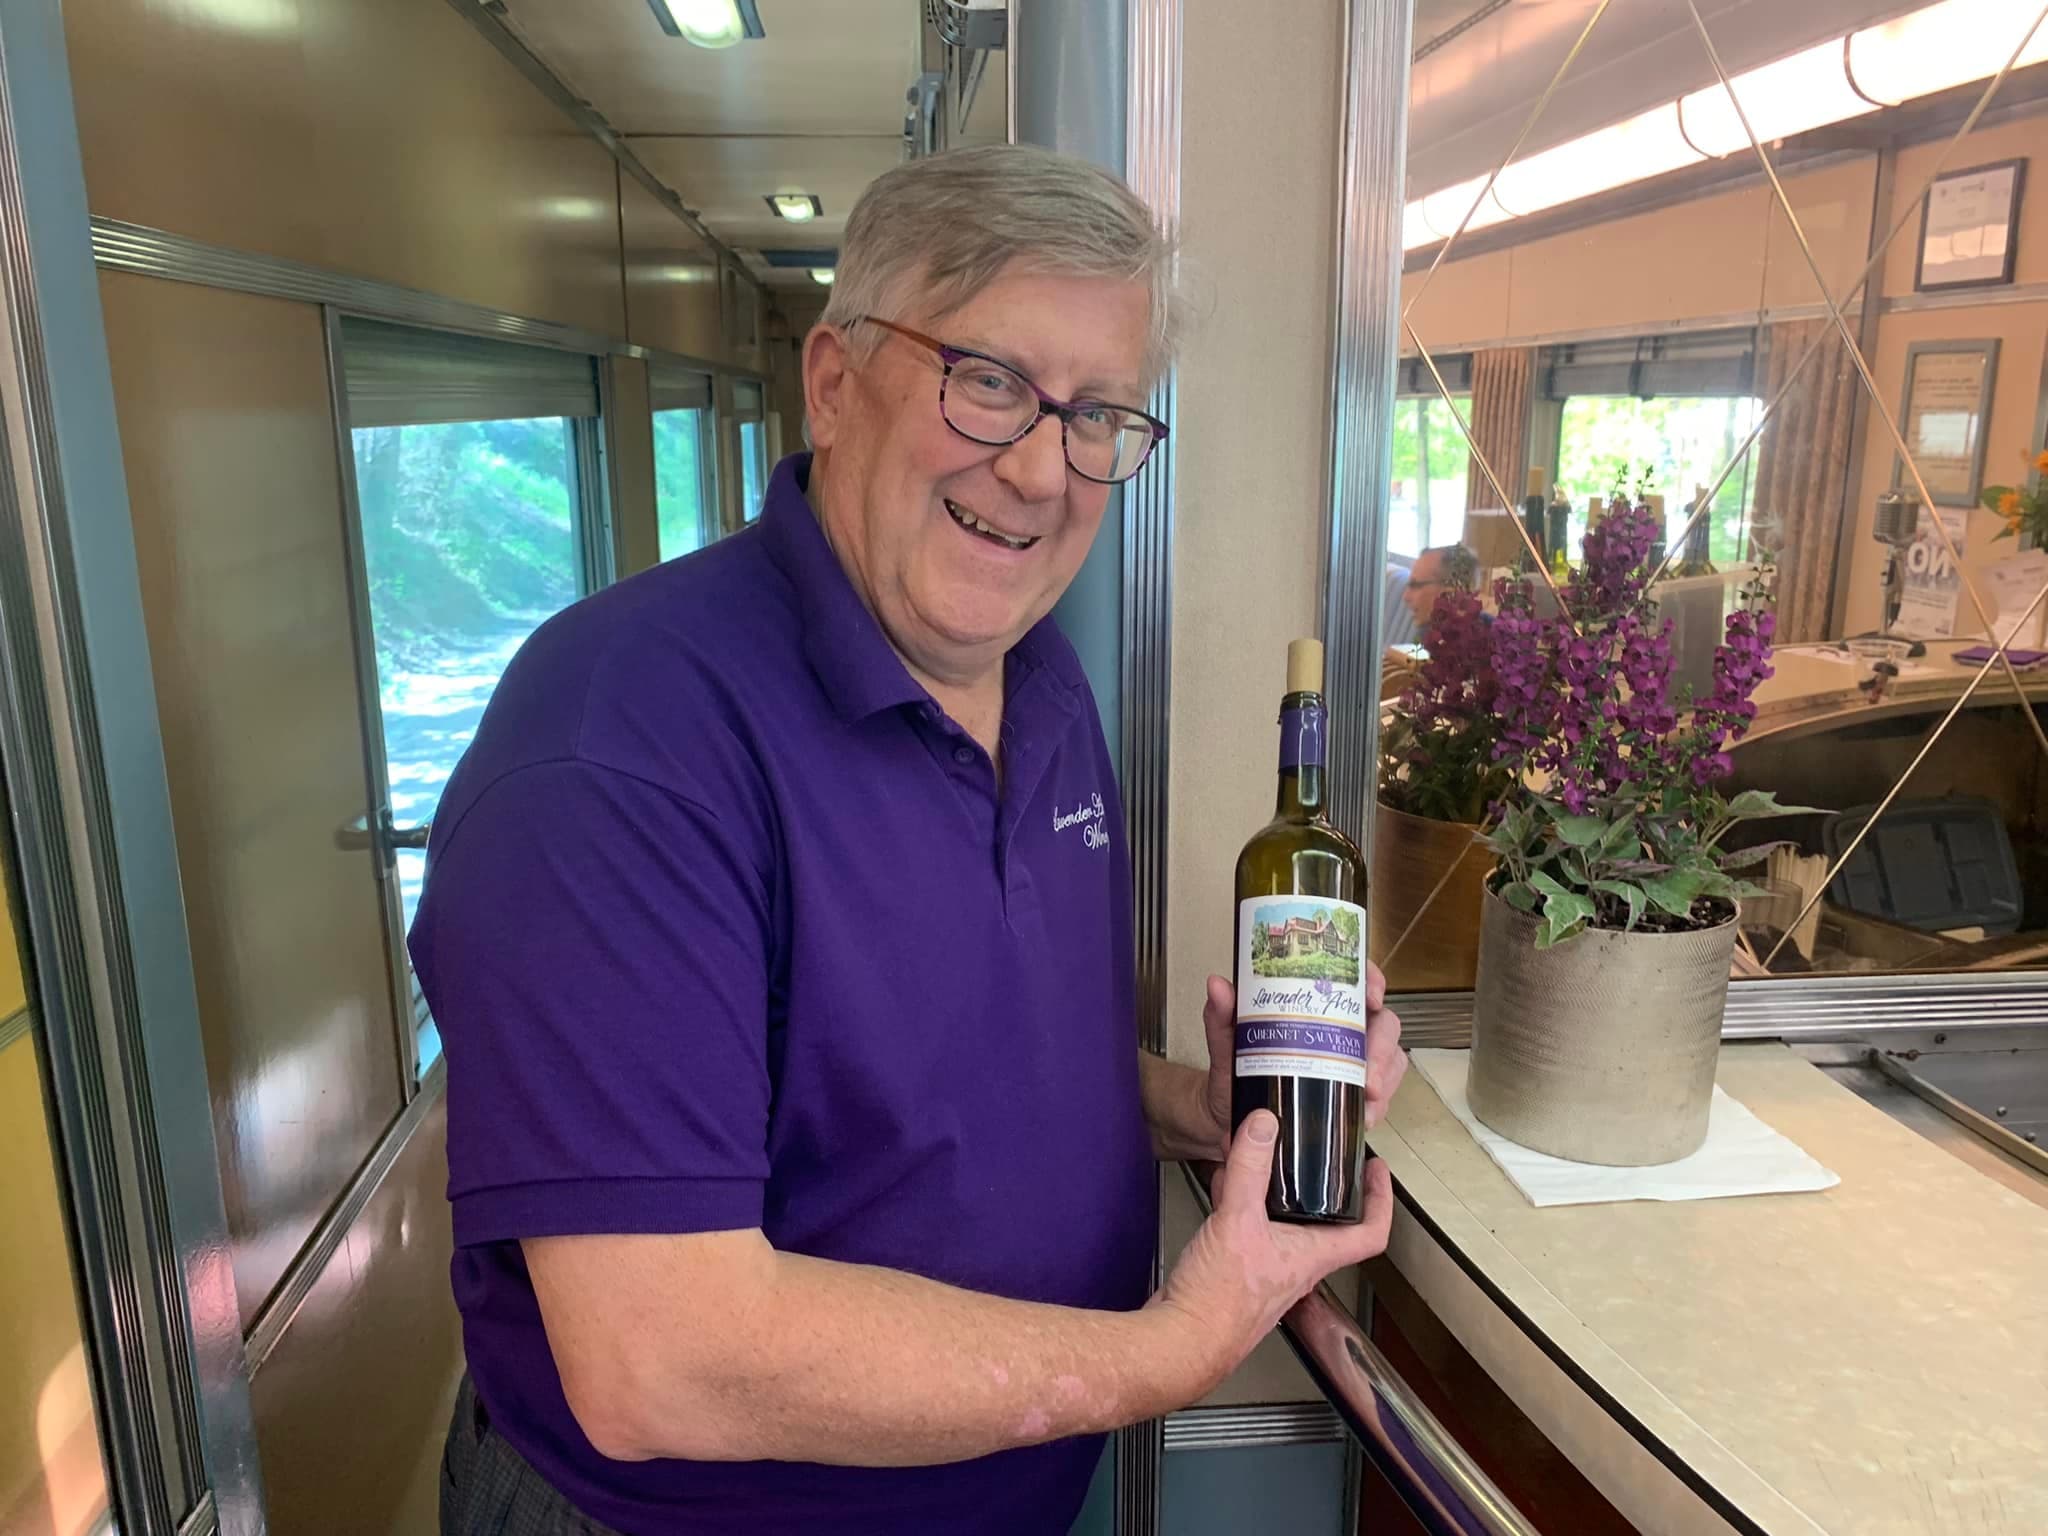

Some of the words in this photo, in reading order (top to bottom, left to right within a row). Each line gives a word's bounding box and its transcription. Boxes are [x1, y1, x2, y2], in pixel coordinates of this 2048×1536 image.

[1252, 987, 1313, 1009] Lavender
[1322, 990, 1361, 1015] Acres
[1279, 1004, 1319, 1015] WINERY
[1246, 1027, 1300, 1043] CABERNET
